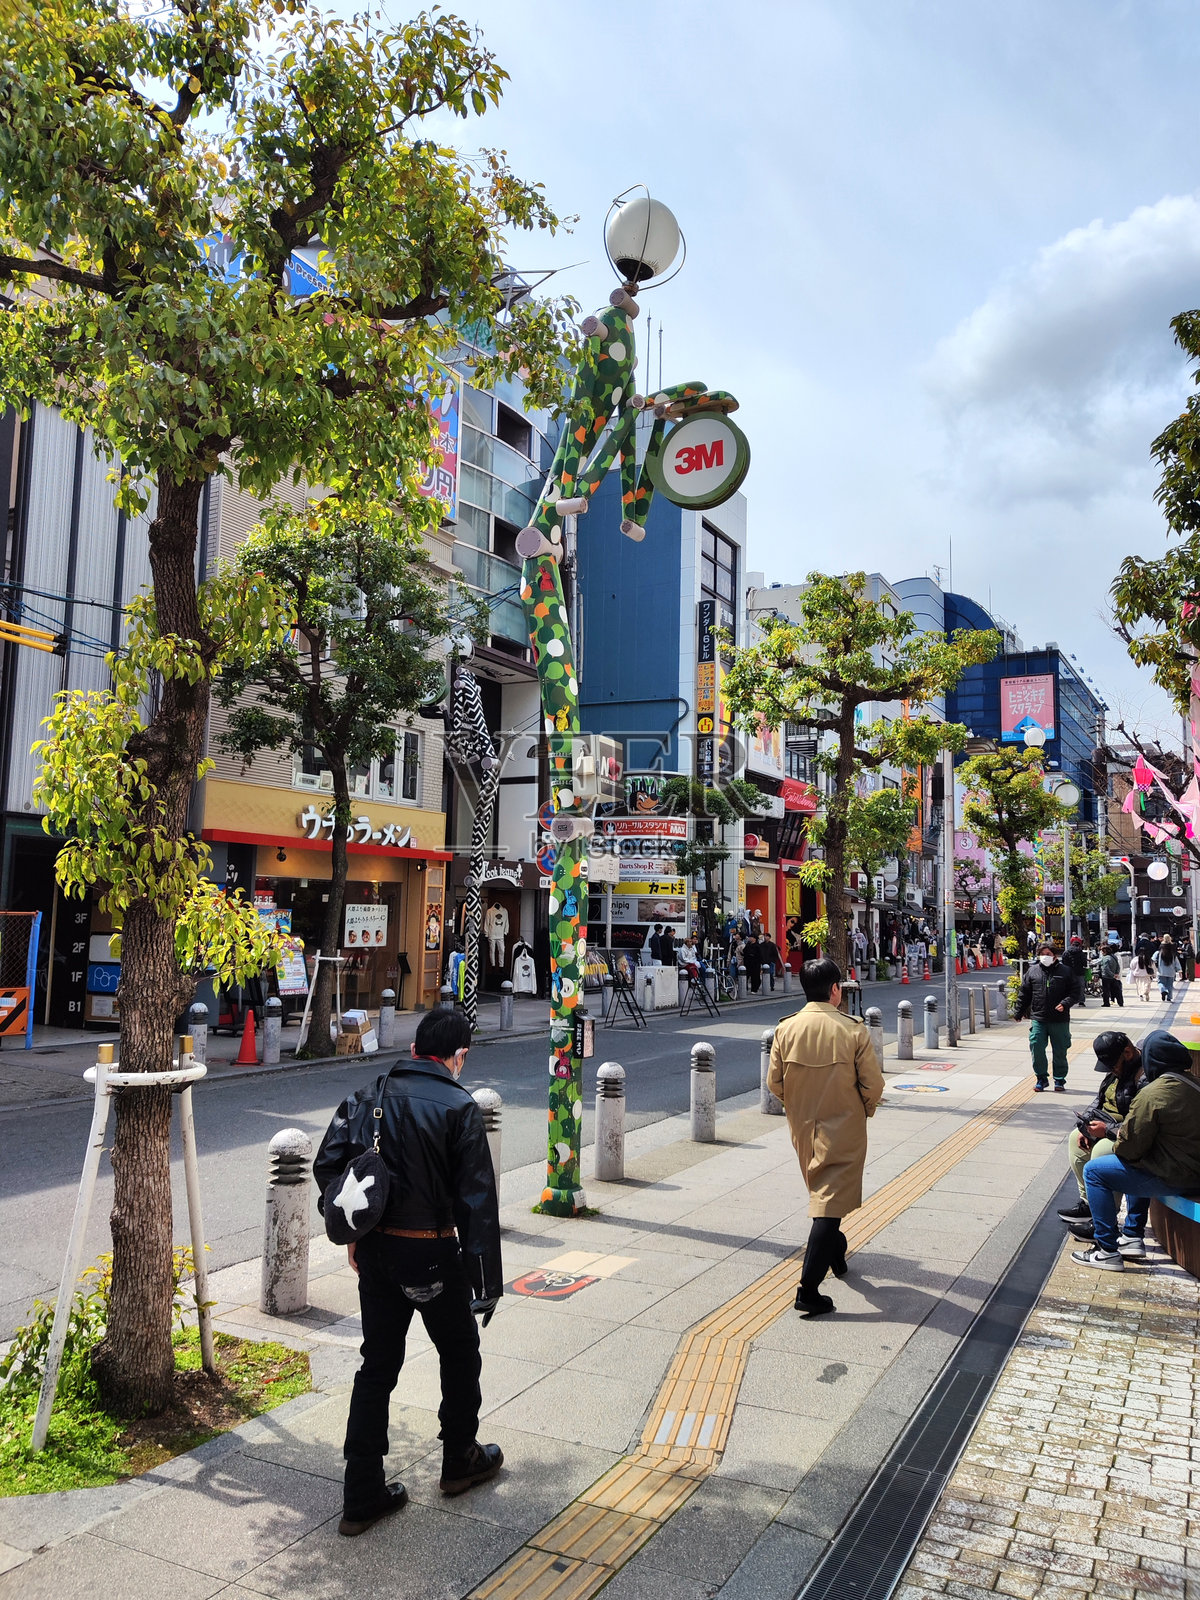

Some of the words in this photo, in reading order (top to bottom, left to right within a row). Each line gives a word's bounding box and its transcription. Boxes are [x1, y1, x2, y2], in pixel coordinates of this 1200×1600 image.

[674, 439, 724, 475] 3M
[702, 603, 710, 660] ワンダー6ビル
[1008, 687, 1045, 704] ヒミツキチ
[1009, 700, 1045, 715] スクラップ
[617, 821, 667, 830] リハーサルスタジオ
[670, 825, 686, 835] MAX
[619, 862, 634, 870] Darts
[634, 862, 648, 871] Shop
[648, 861, 654, 870] R
[648, 882, 685, 895] カード王
[74, 913, 88, 924] 3F
[72, 942, 86, 953] 2F
[71, 971, 83, 983] 1F
[68, 1001, 81, 1012] B1
